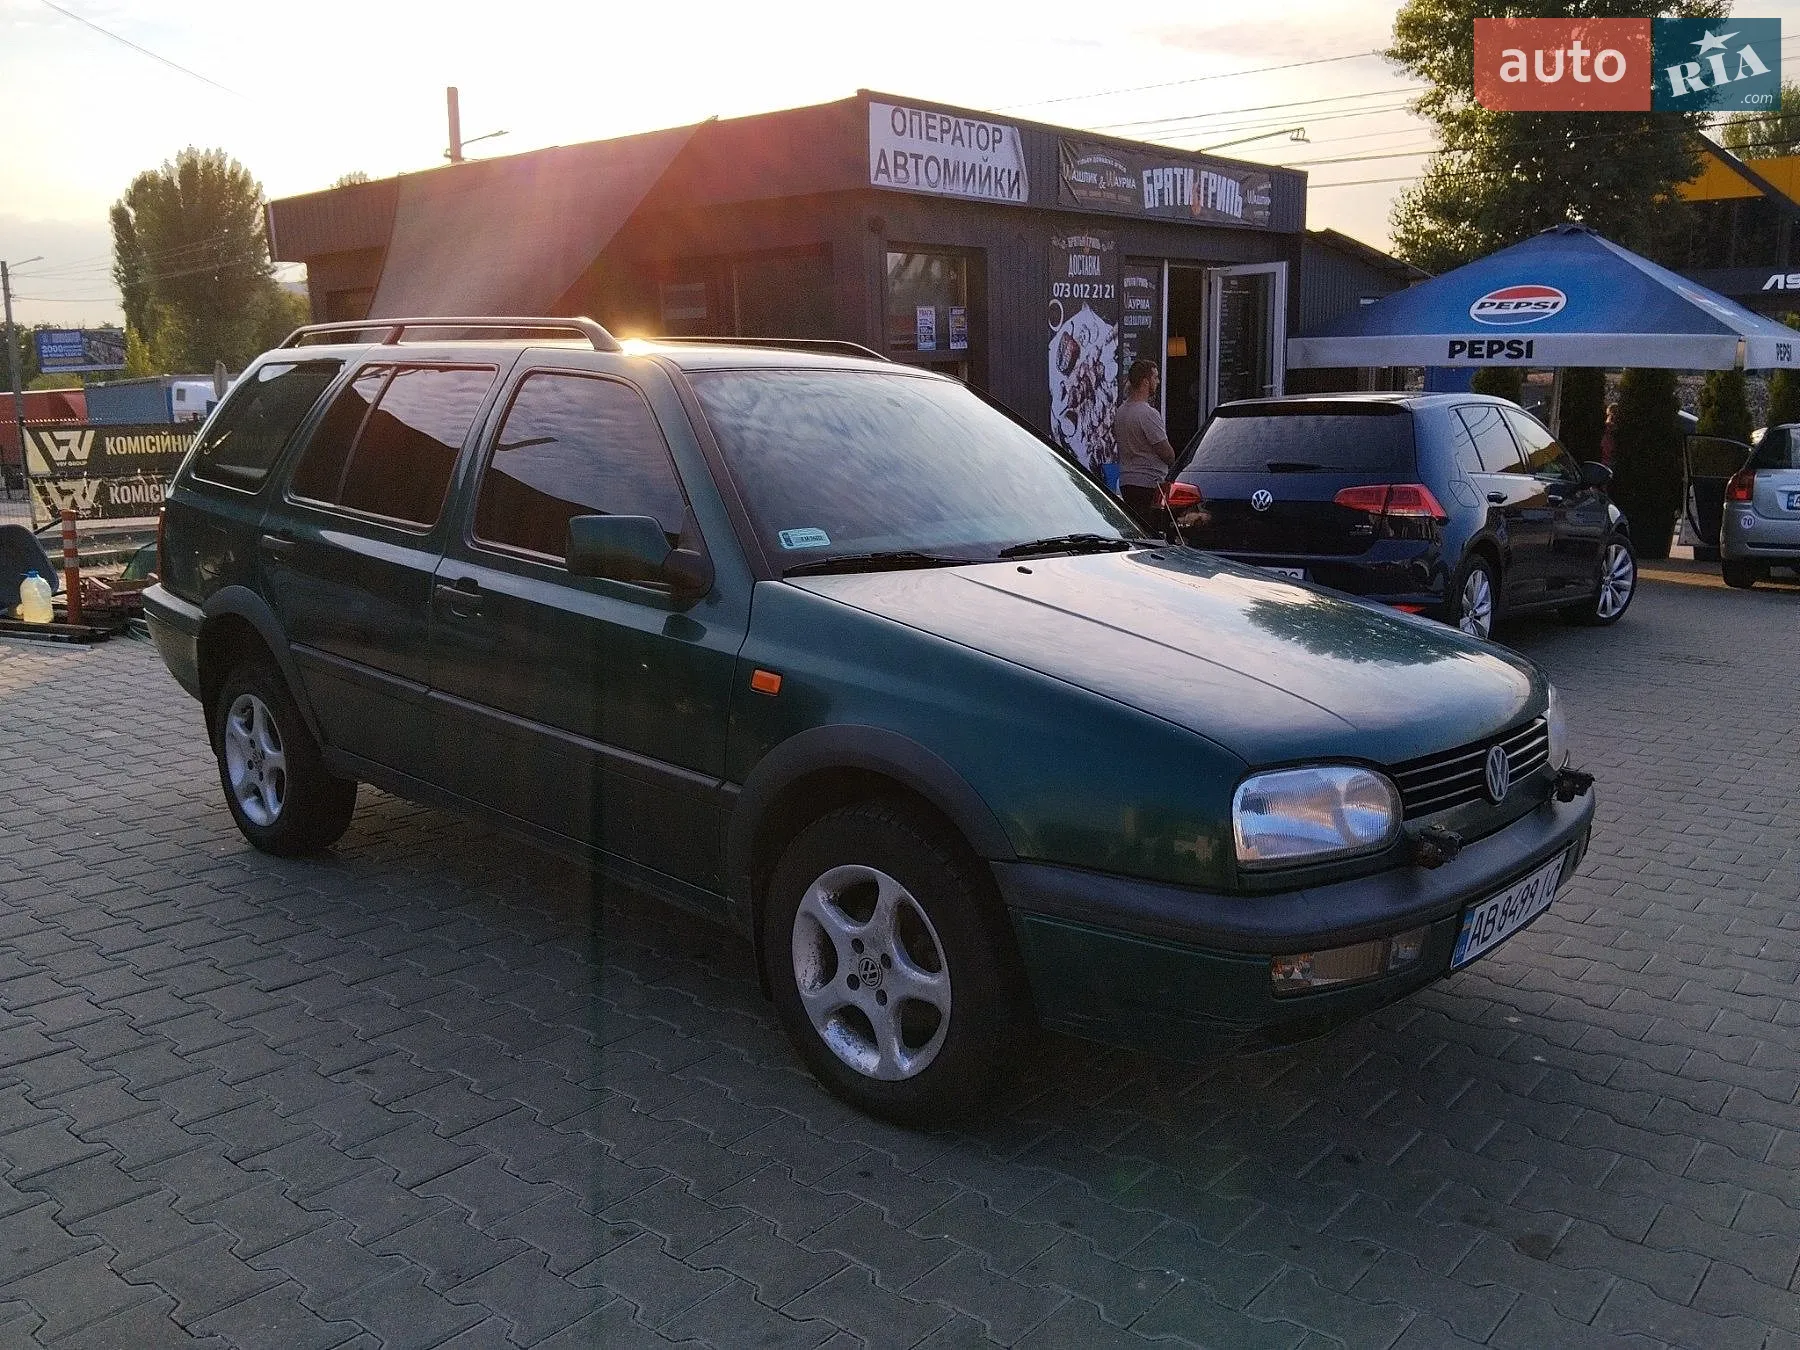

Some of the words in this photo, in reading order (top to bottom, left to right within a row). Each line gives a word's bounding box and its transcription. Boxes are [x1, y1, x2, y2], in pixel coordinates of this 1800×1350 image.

[891, 107, 1003, 153] ОПЕРАТОР
[873, 148, 1021, 200] АВТОМИЙКИ
[1142, 167, 1195, 210] БРАТИ
[1200, 170, 1243, 218] ГРИЛЬ
[1068, 254, 1101, 278] ДОСТАВКА
[1053, 282, 1071, 298] 073
[1073, 283, 1090, 298] 012
[1477, 301, 1560, 310] PEPSI
[1448, 339, 1534, 360] PEPSI
[105, 431, 200, 455] КОМІСІЙНИ
